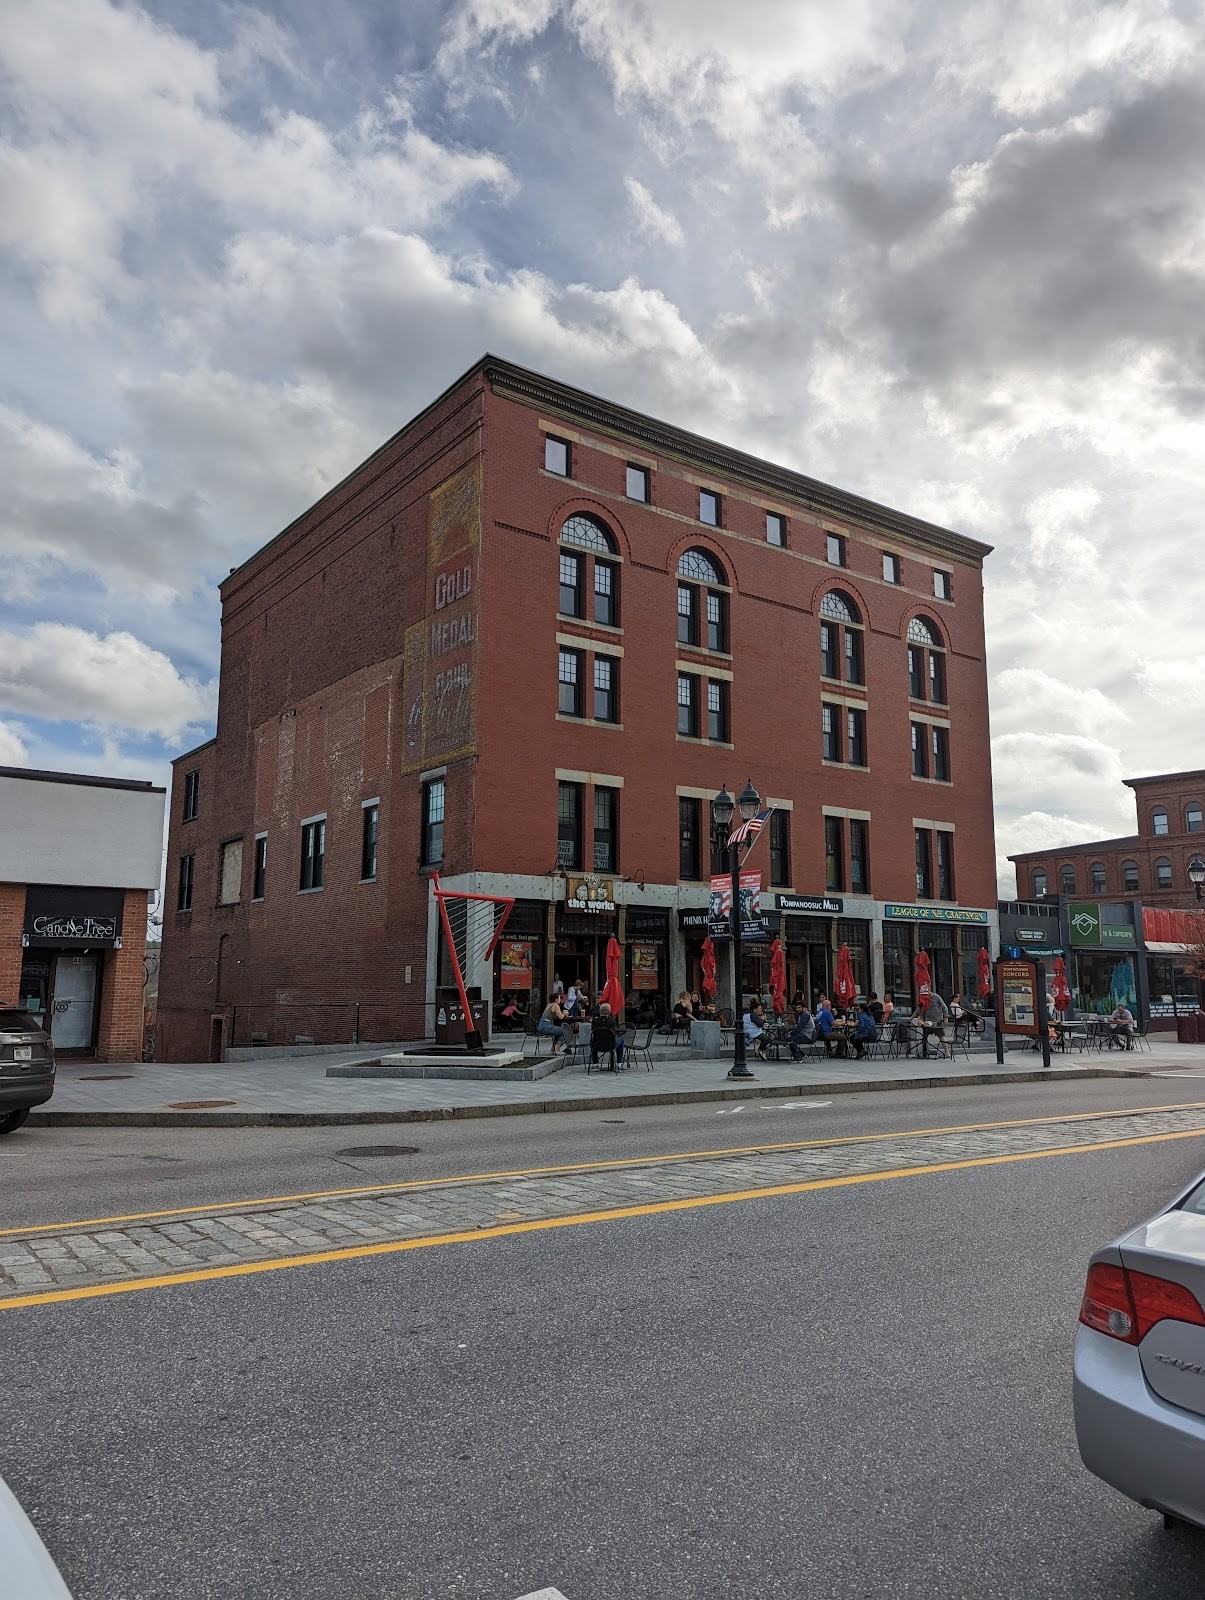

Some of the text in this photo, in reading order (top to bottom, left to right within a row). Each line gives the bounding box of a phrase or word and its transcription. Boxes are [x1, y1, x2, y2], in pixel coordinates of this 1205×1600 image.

[435, 565, 472, 611] GOLD
[431, 612, 474, 657] MEDAL
[568, 898, 615, 910] the works
[823, 899, 840, 911] MILLS
[683, 915, 703, 925] PHENIX
[891, 907, 919, 917] LEAGUE
[919, 909, 929, 917] OF
[945, 911, 983, 921] CRAFTSMEN
[33, 916, 114, 935] Candle Tree
[558, 941, 568, 949] 42
[73, 957, 83, 965] 44
